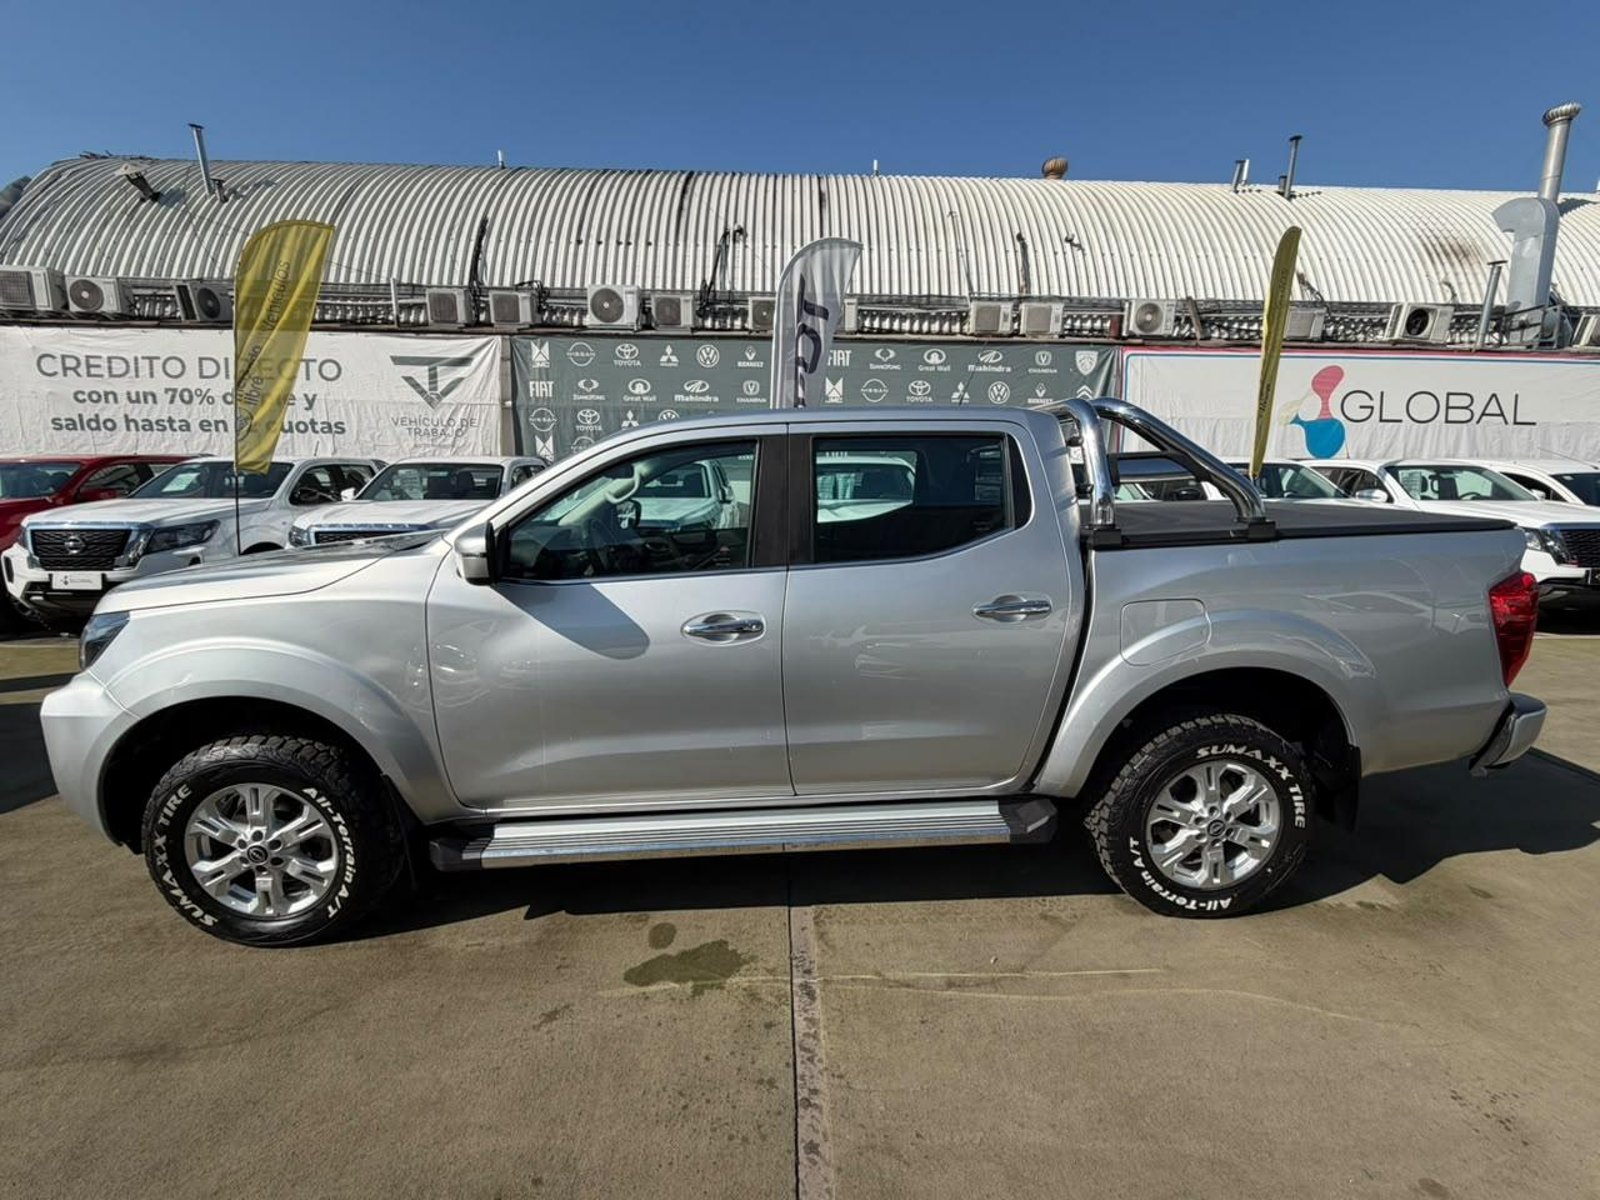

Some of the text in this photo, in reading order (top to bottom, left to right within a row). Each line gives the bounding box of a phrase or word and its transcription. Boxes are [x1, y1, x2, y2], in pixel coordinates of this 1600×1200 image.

[36, 353, 186, 379] CREDITO
[613, 359, 641, 367] TOYOTA
[827, 350, 852, 366] FIAT
[968, 364, 1012, 372] Mahindra
[73, 389, 119, 405] con
[126, 389, 159, 405] un
[164, 387, 216, 406] 70%
[303, 392, 318, 410] y
[529, 381, 554, 398] FIAT
[622, 394, 657, 402] Great Wall
[674, 393, 719, 402] Mahindra
[1340, 389, 1537, 426] GLOBAL
[50, 412, 118, 432] saldo
[123, 413, 192, 432] hasta
[198, 418, 229, 433] en
[460, 417, 479, 428] DE
[405, 427, 464, 438] TRABAJO
[158, 784, 193, 827] TIRE
[1288, 783, 1306, 829] TIRE
[302, 786, 356, 919] All-Terrain A/T
[1129, 836, 1233, 911] All-Terrain A/T
